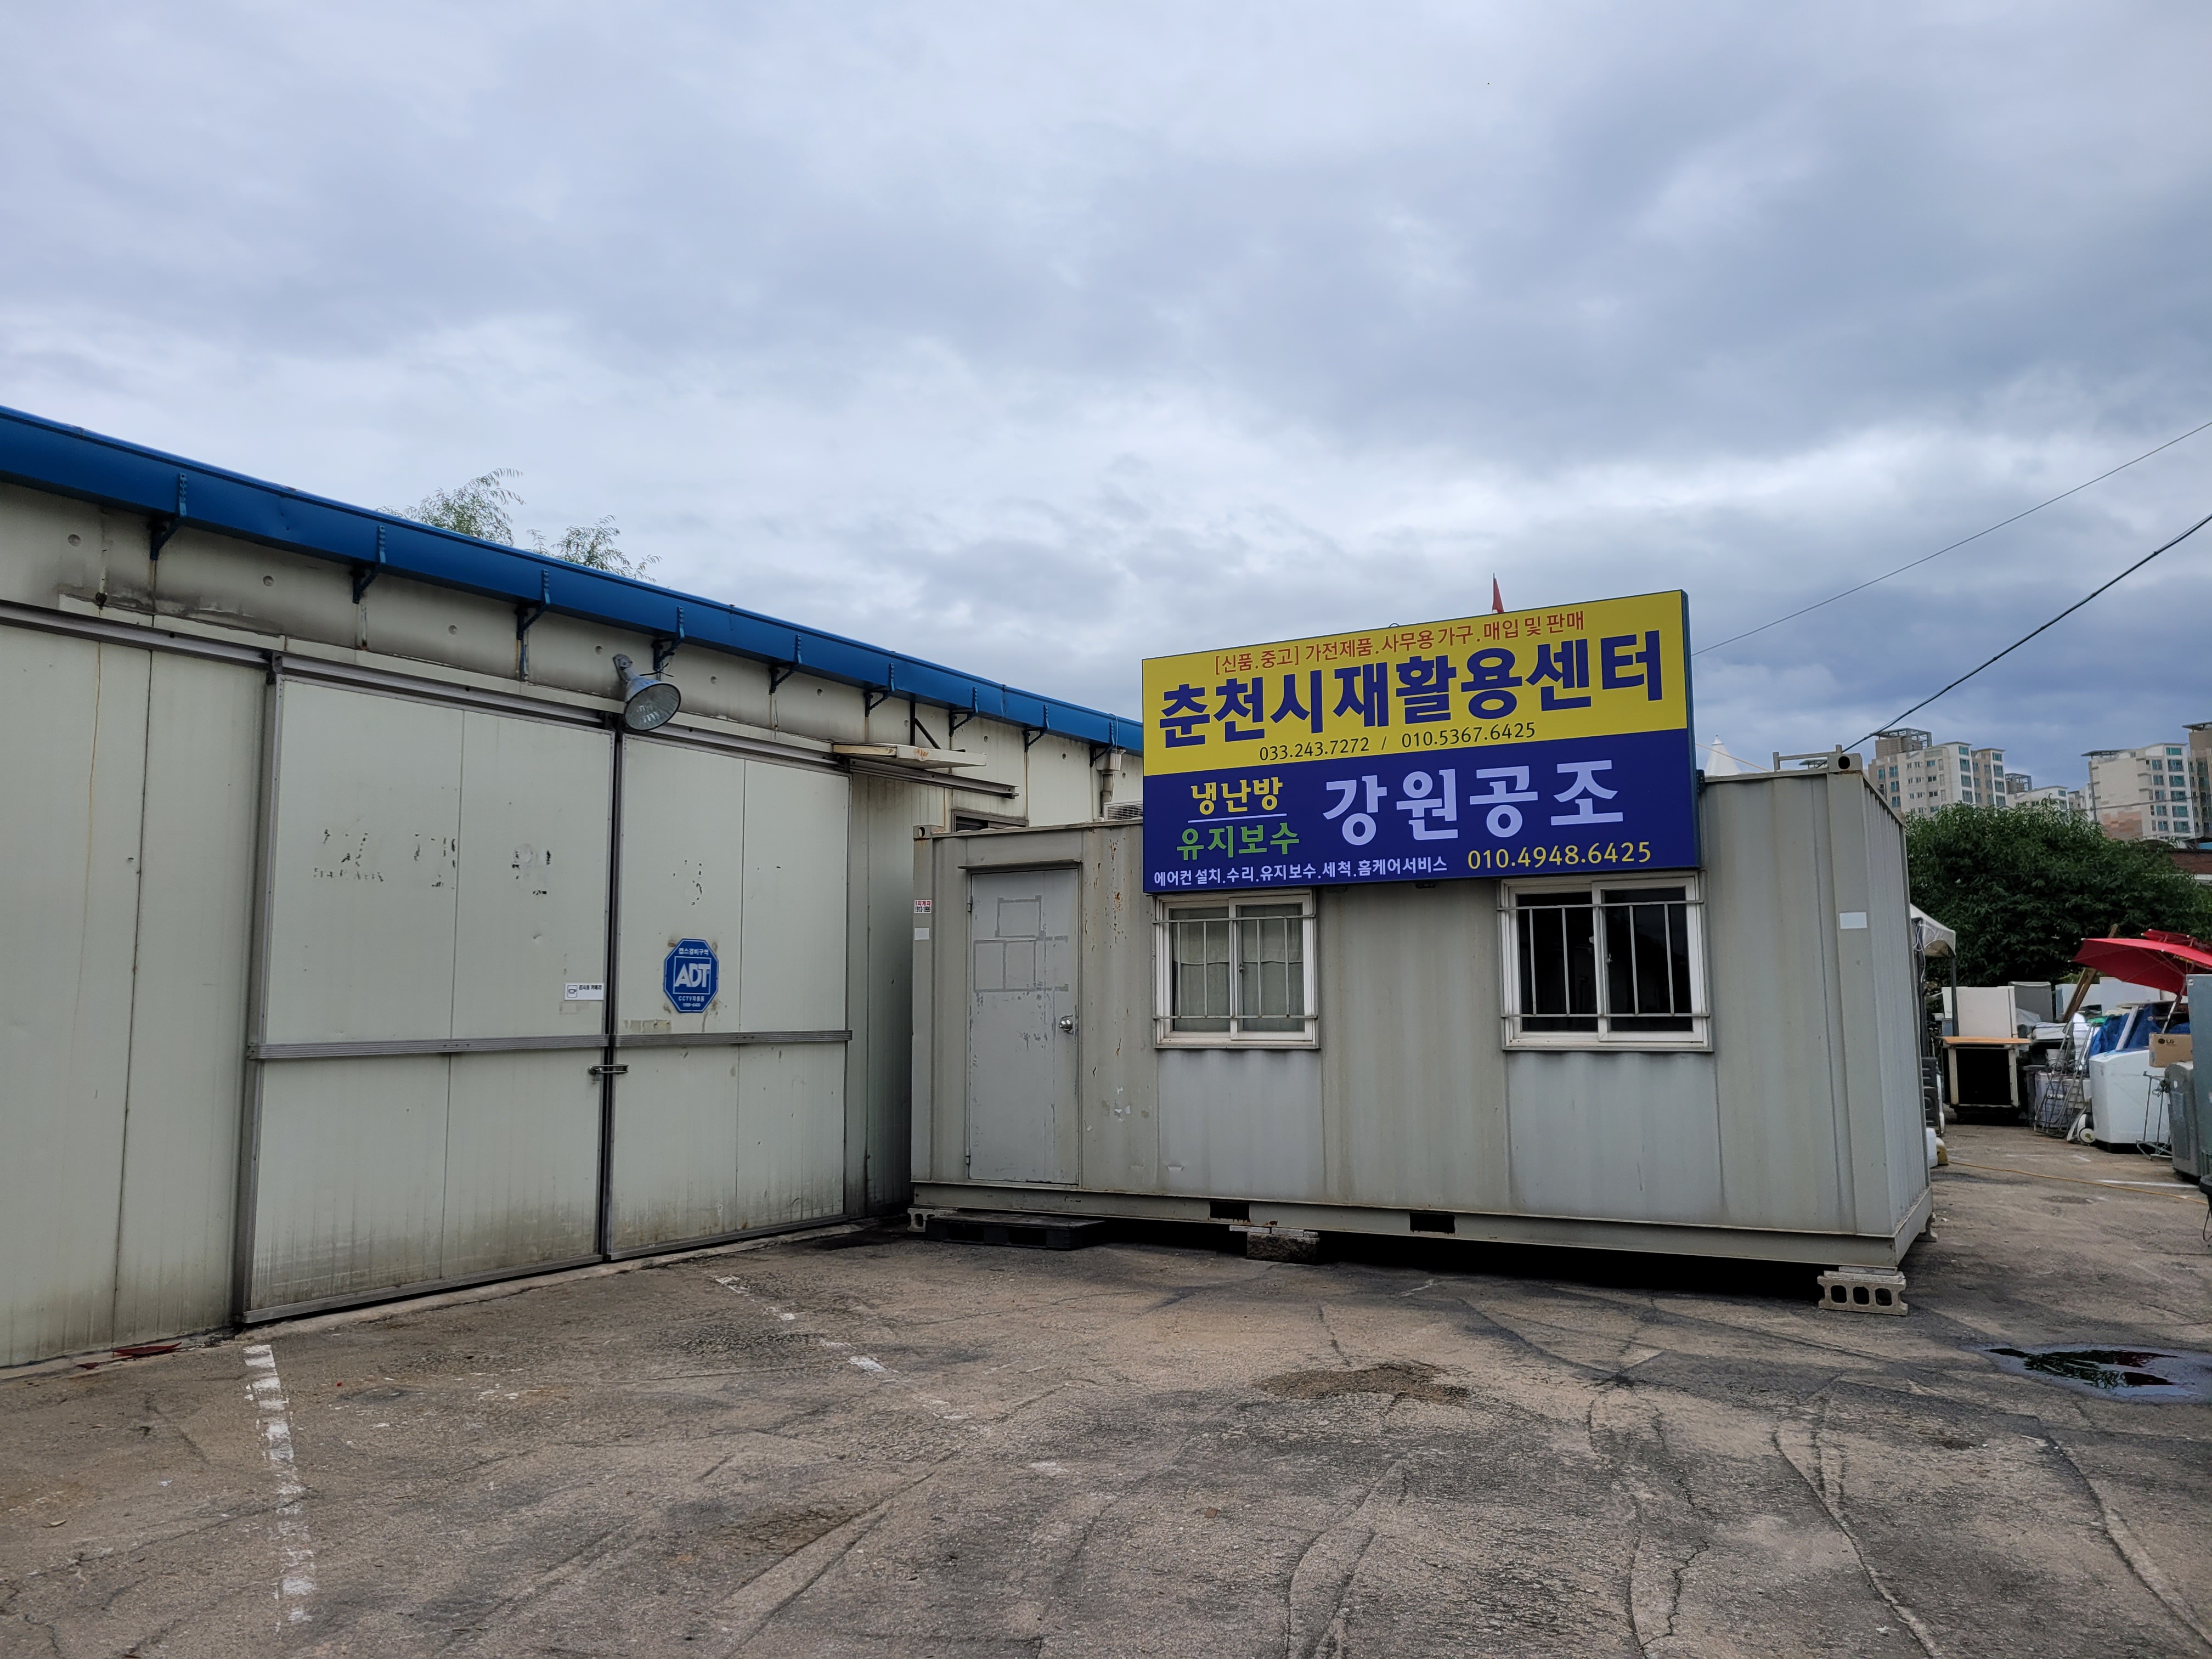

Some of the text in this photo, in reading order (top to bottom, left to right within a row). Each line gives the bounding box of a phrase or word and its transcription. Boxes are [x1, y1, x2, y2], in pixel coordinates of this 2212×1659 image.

[1525, 616, 1541, 637] 및
[1546, 610, 1584, 634] 판매
[1160, 630, 1662, 748] 춘천시재활용센터
[1260, 737, 1369, 761] 033.243.7272
[1402, 722, 1535, 748] 010.5367.6425
[1191, 776, 1283, 815] 냉난방
[1323, 760, 1624, 845] 강원공조
[1177, 823, 1300, 860] 유지보수
[1468, 842, 1651, 870] 010.4948.6425
[674, 963, 710, 988] ADT
